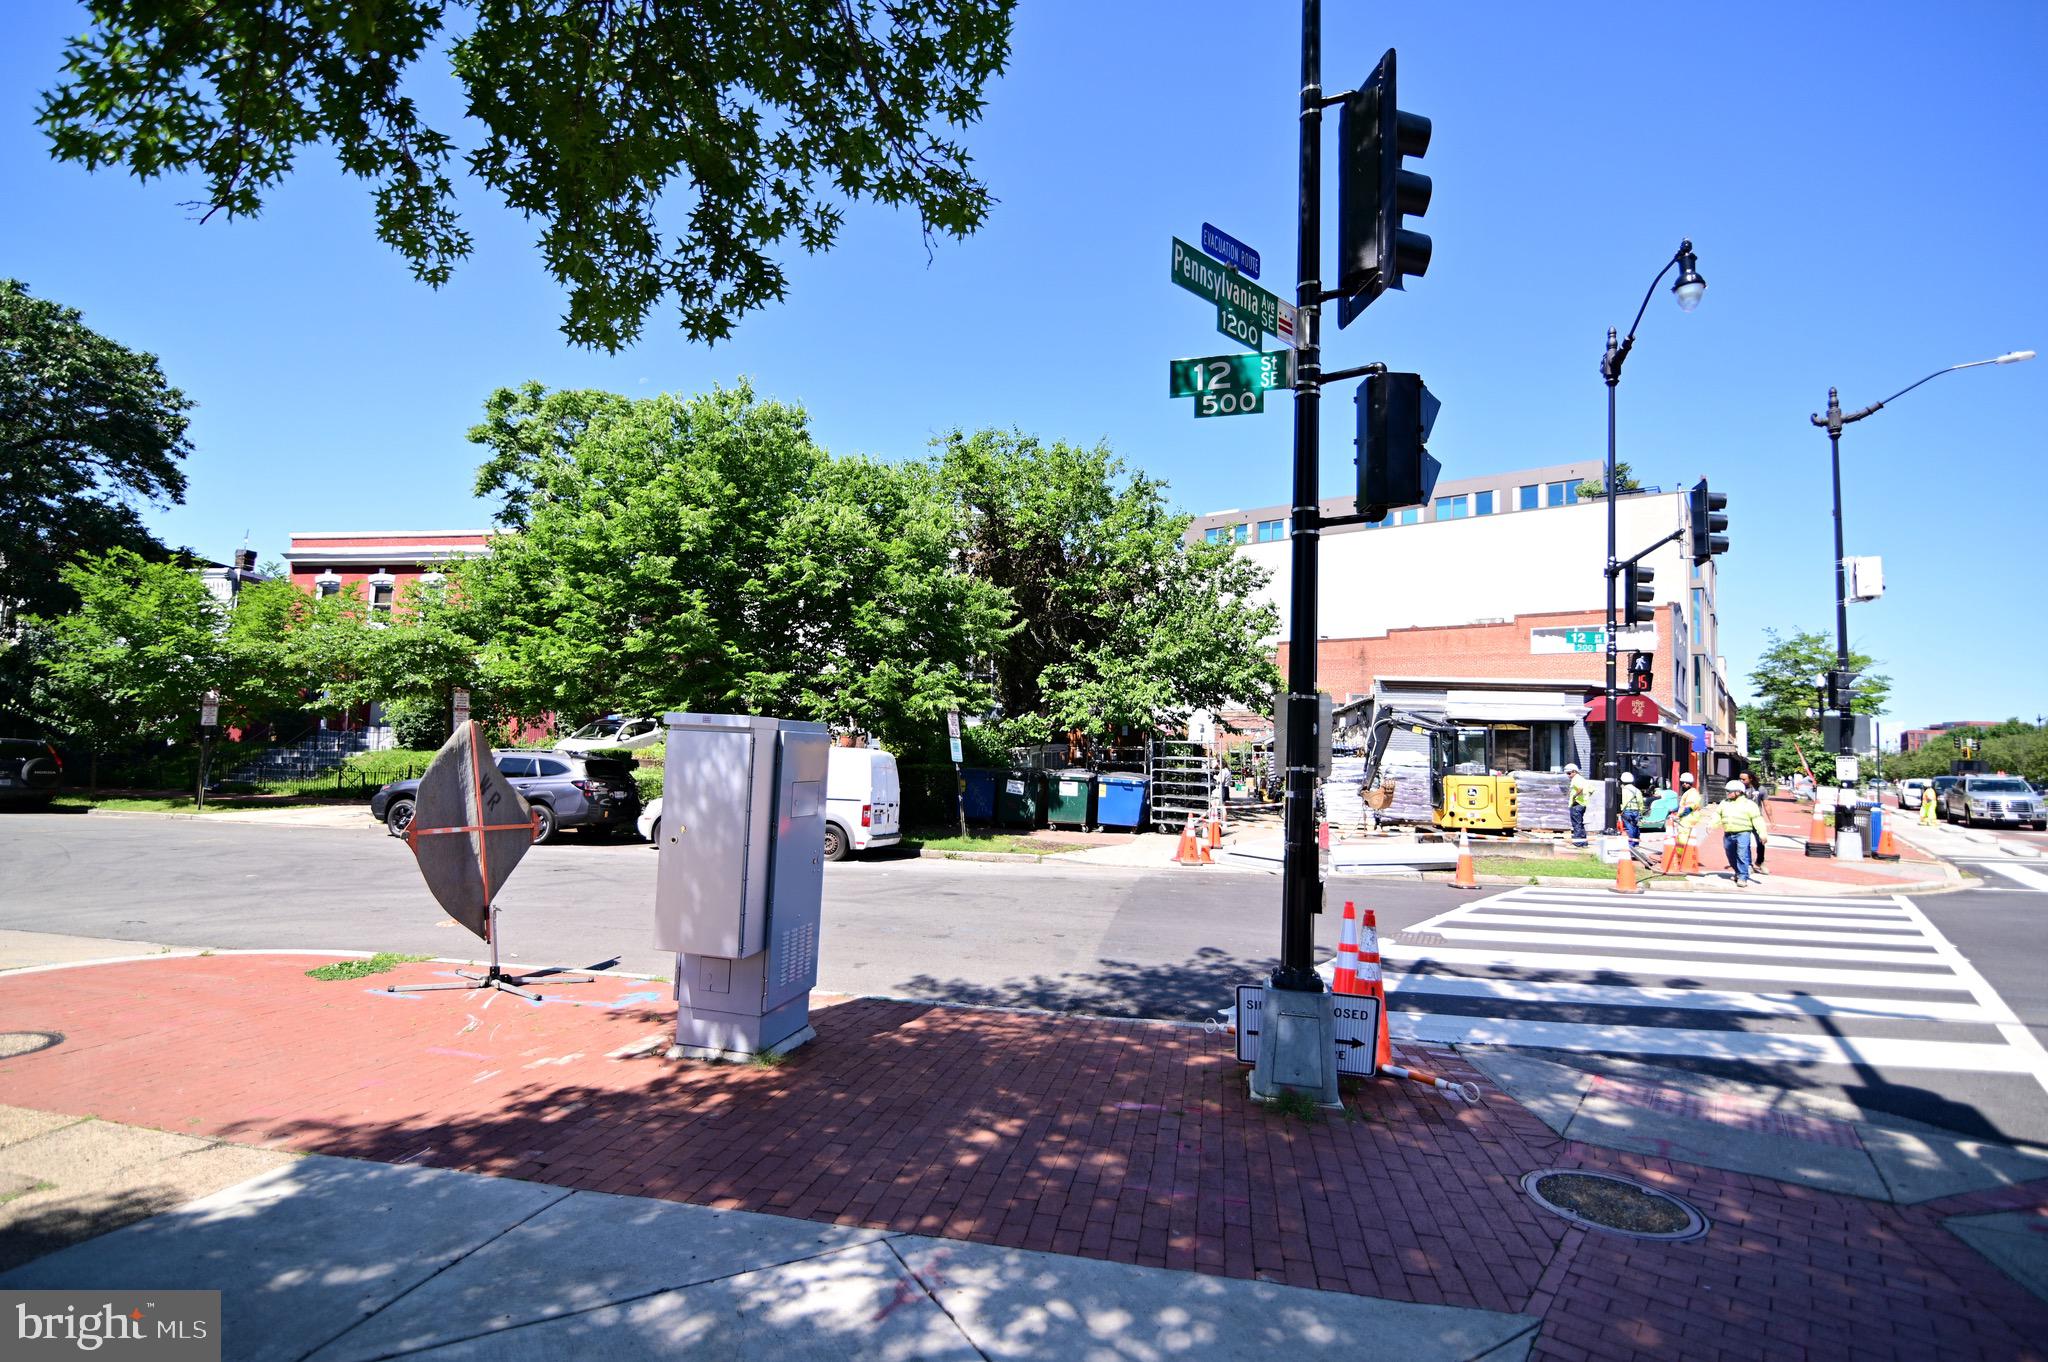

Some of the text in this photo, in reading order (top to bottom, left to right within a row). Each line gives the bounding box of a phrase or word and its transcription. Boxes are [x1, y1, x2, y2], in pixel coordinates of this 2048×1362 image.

[1203, 229, 1258, 273] EVACUATION ROUTE
[1174, 243, 1275, 315] Pennsylvania Ave
[1221, 310, 1258, 345] 1200
[1261, 310, 1275, 330] SE
[1260, 355, 1277, 372] St
[1194, 362, 1231, 390] 12
[1260, 371, 1278, 388] SE
[1202, 392, 1256, 414] 500
[1571, 633, 1586, 643] 12
[1638, 674, 1647, 689] 15
[1334, 1008, 1368, 1020] OSED
